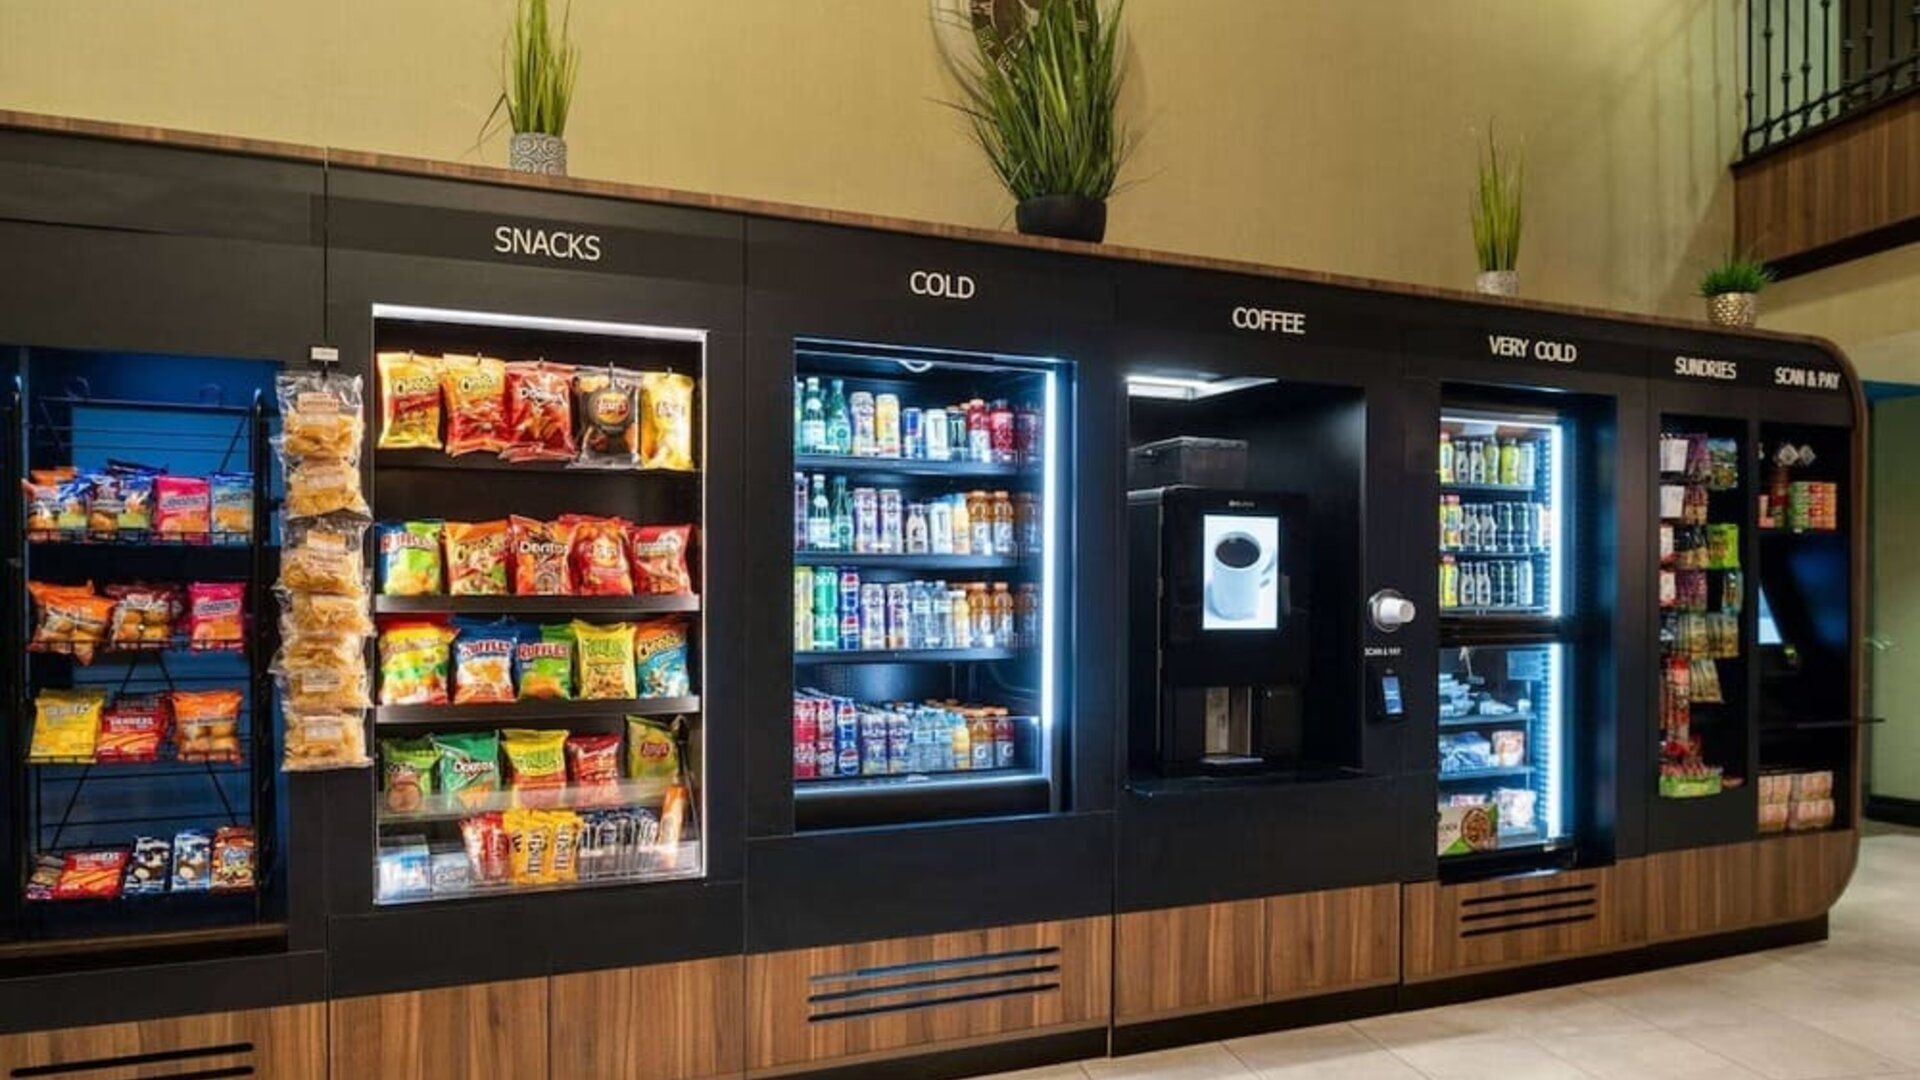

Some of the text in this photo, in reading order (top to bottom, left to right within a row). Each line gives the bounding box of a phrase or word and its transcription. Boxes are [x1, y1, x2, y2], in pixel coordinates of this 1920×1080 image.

[494, 225, 601, 261] SNACKS
[909, 270, 976, 300] COLD
[1231, 306, 1307, 335] COFFEE
[1488, 335, 1578, 363] VERY COLD
[1674, 355, 1738, 380] SUNDRIES
[1774, 366, 1842, 390] SCAN & PAY
[519, 540, 569, 557] Doritos
[517, 642, 570, 660] RUFFLES
